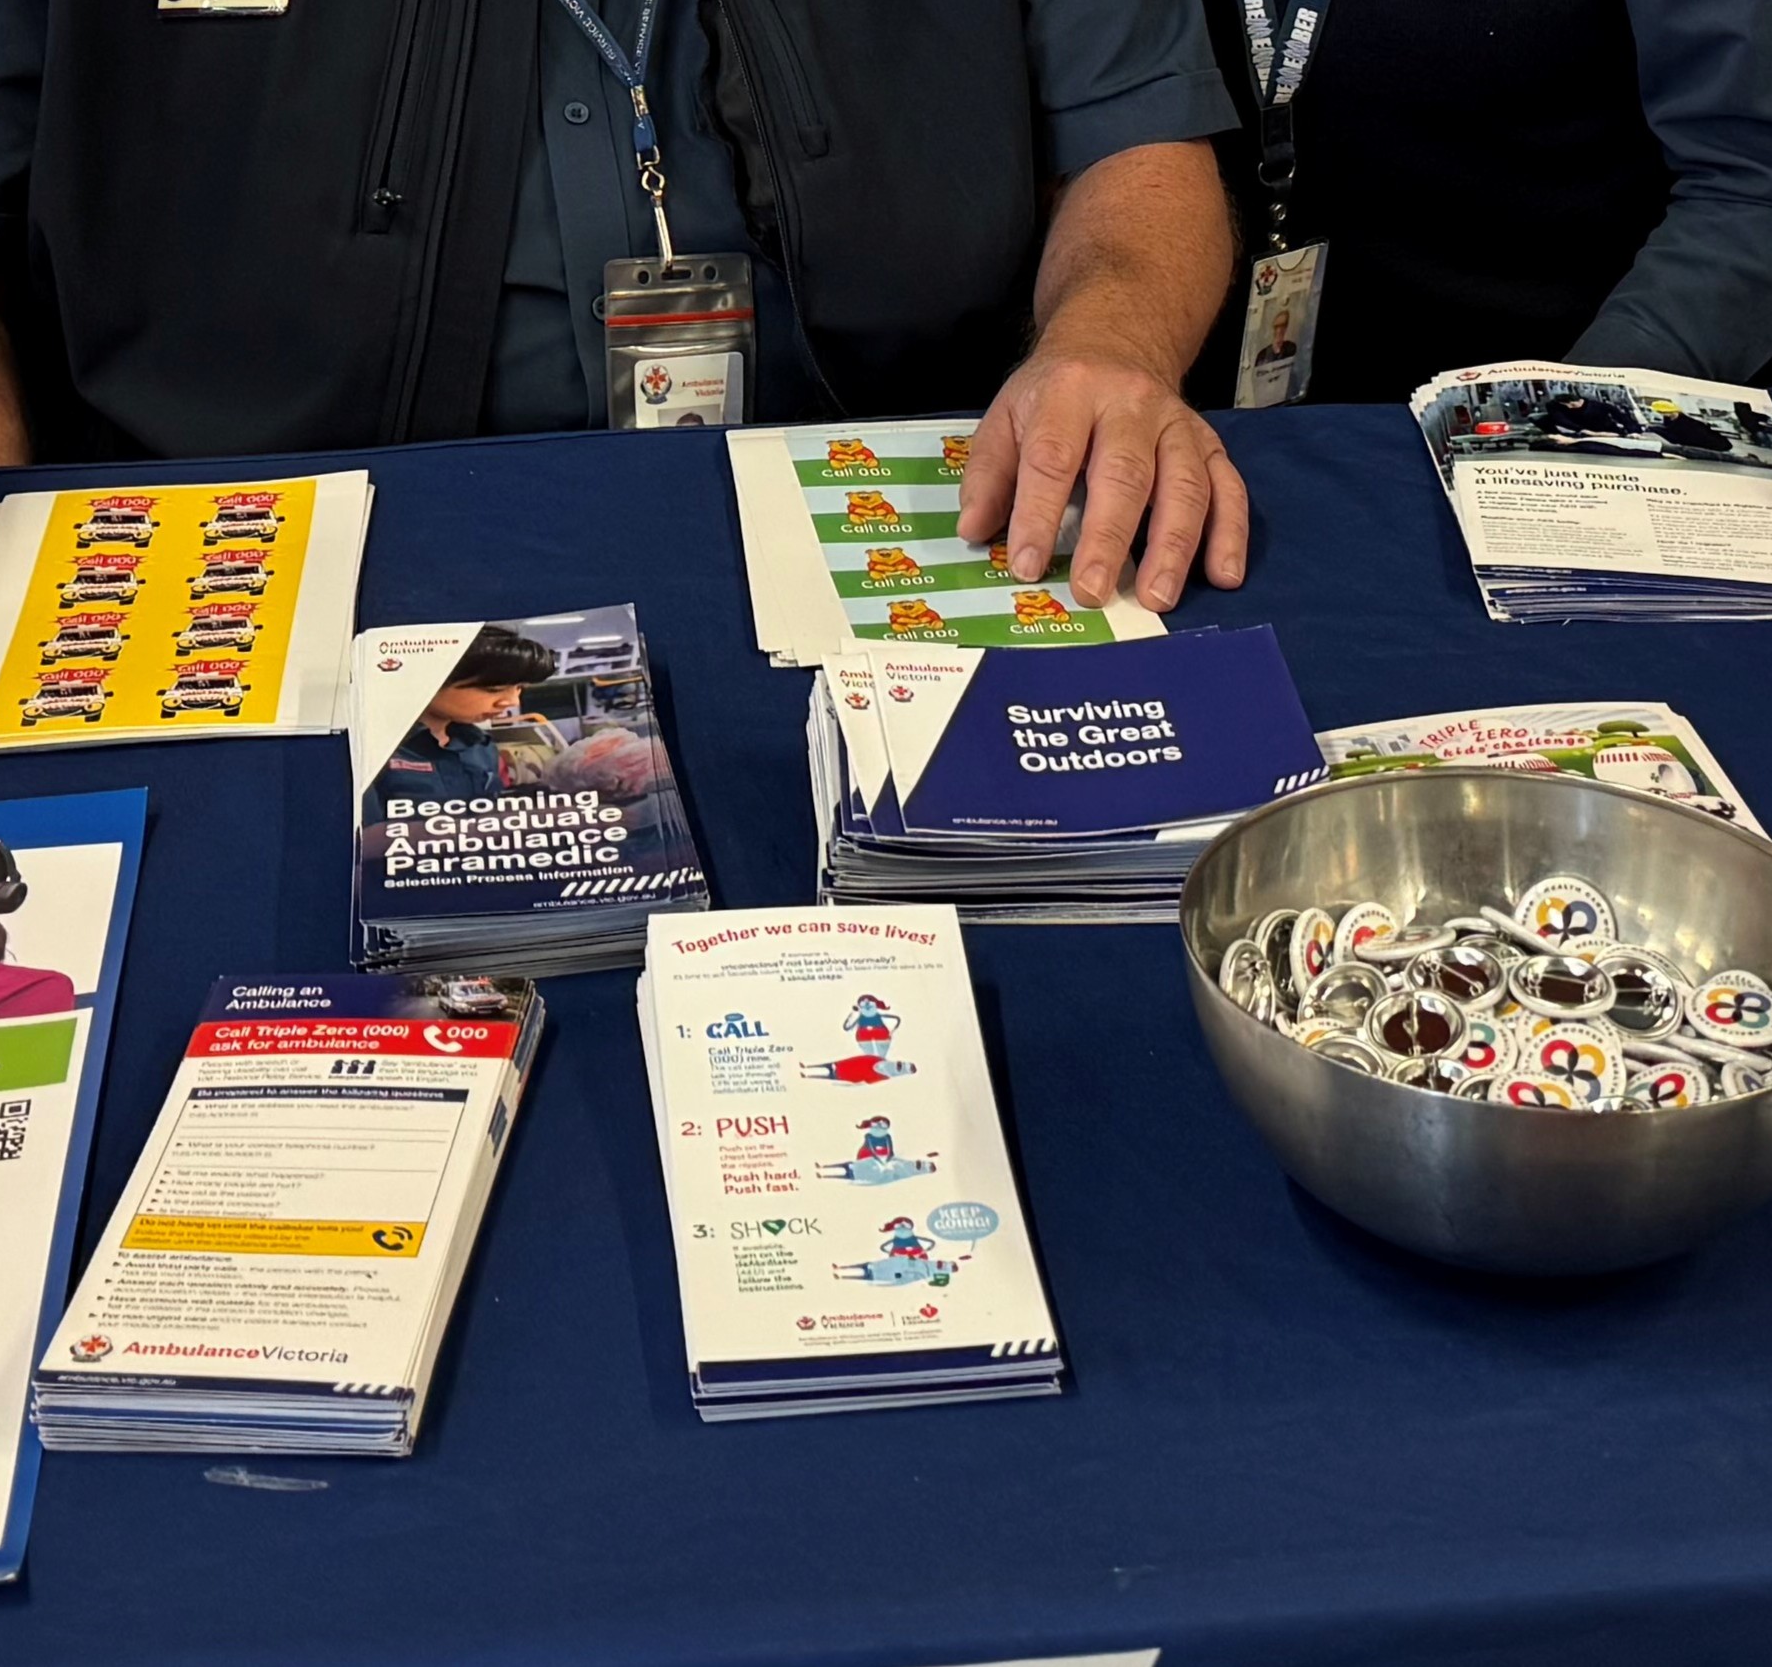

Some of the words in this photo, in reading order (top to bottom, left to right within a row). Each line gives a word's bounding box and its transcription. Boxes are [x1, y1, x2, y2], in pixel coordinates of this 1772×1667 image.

[821, 467, 853, 479] Call
[858, 467, 892, 477] 000
[1474, 468, 1538, 479] You've
[1544, 468, 1579, 482] just
[1585, 472, 1640, 483] made
[1491, 477, 1586, 491] lifesaving
[1591, 483, 1688, 496] purchase.
[885, 661, 964, 674] Ambulance
[886, 671, 942, 682] Victoria
[1007, 700, 1165, 725] Surviving
[1013, 726, 1068, 747] the
[1078, 720, 1175, 746] Great
[1419, 719, 1479, 749] TRIPLE
[1473, 728, 1528, 742] ZERO
[1493, 737, 1586, 749] challenge
[1019, 743, 1183, 773] Outdoors
[386, 789, 599, 819] Becoming
[385, 822, 410, 838] a
[425, 806, 623, 837] Graduate
[384, 825, 628, 858] Ambulance
[385, 845, 620, 876] Paramedic
[383, 876, 463, 889] Selection
[466, 872, 533, 884] Process
[538, 866, 634, 881] Information
[671, 925, 760, 956] Together
[764, 923, 793, 936] we
[797, 920, 832, 934] can
[836, 921, 881, 936] save
[884, 925, 937, 946] lives!
[232, 985, 295, 998] Calling
[300, 986, 323, 995] an
[226, 998, 331, 1010] Ambulance
[215, 1026, 250, 1038] Call
[256, 1025, 309, 1039] Triple
[314, 1025, 359, 1037] Zero
[363, 1024, 410, 1039] (000)
[446, 1026, 488, 1040] 000
[705, 1020, 770, 1039] CALL
[715, 1115, 789, 1138] PUSH
